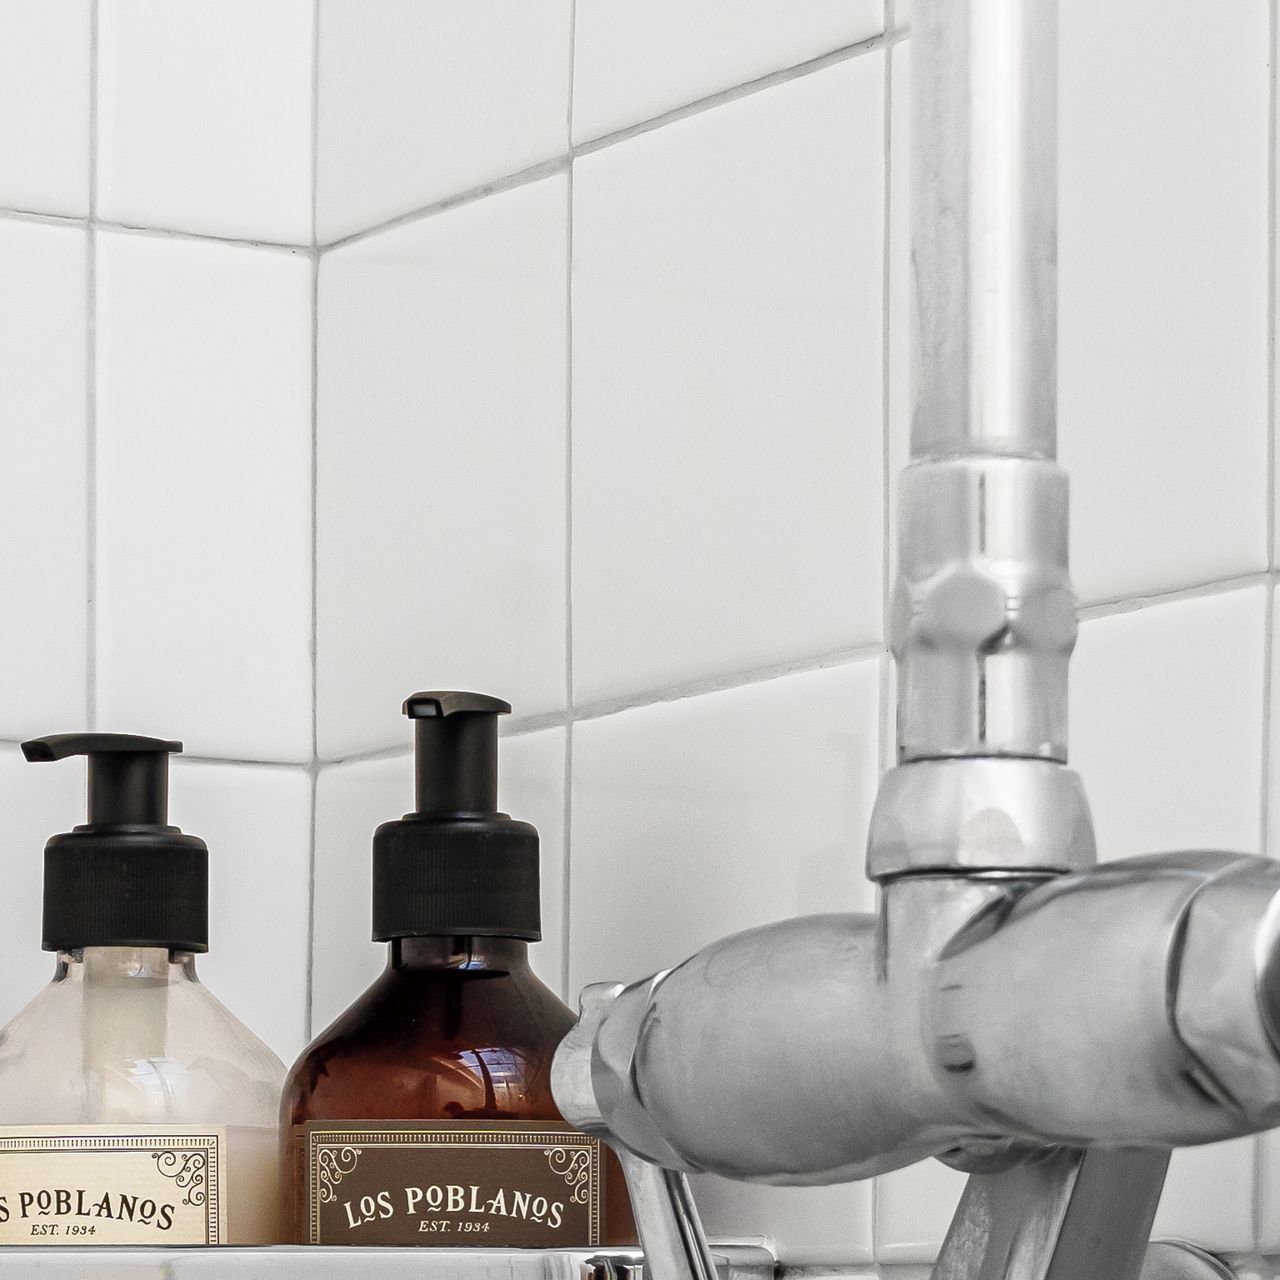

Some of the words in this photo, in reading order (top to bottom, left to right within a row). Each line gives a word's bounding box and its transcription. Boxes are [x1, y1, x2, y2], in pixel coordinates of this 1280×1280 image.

[18, 1189, 176, 1231] POBLANOS
[343, 1191, 394, 1229] LOS
[405, 1185, 564, 1229] POBLANOS
[30, 1224, 59, 1236] EST.
[65, 1224, 96, 1236] 1934
[418, 1220, 451, 1232] EST.
[457, 1222, 490, 1233] 1934
